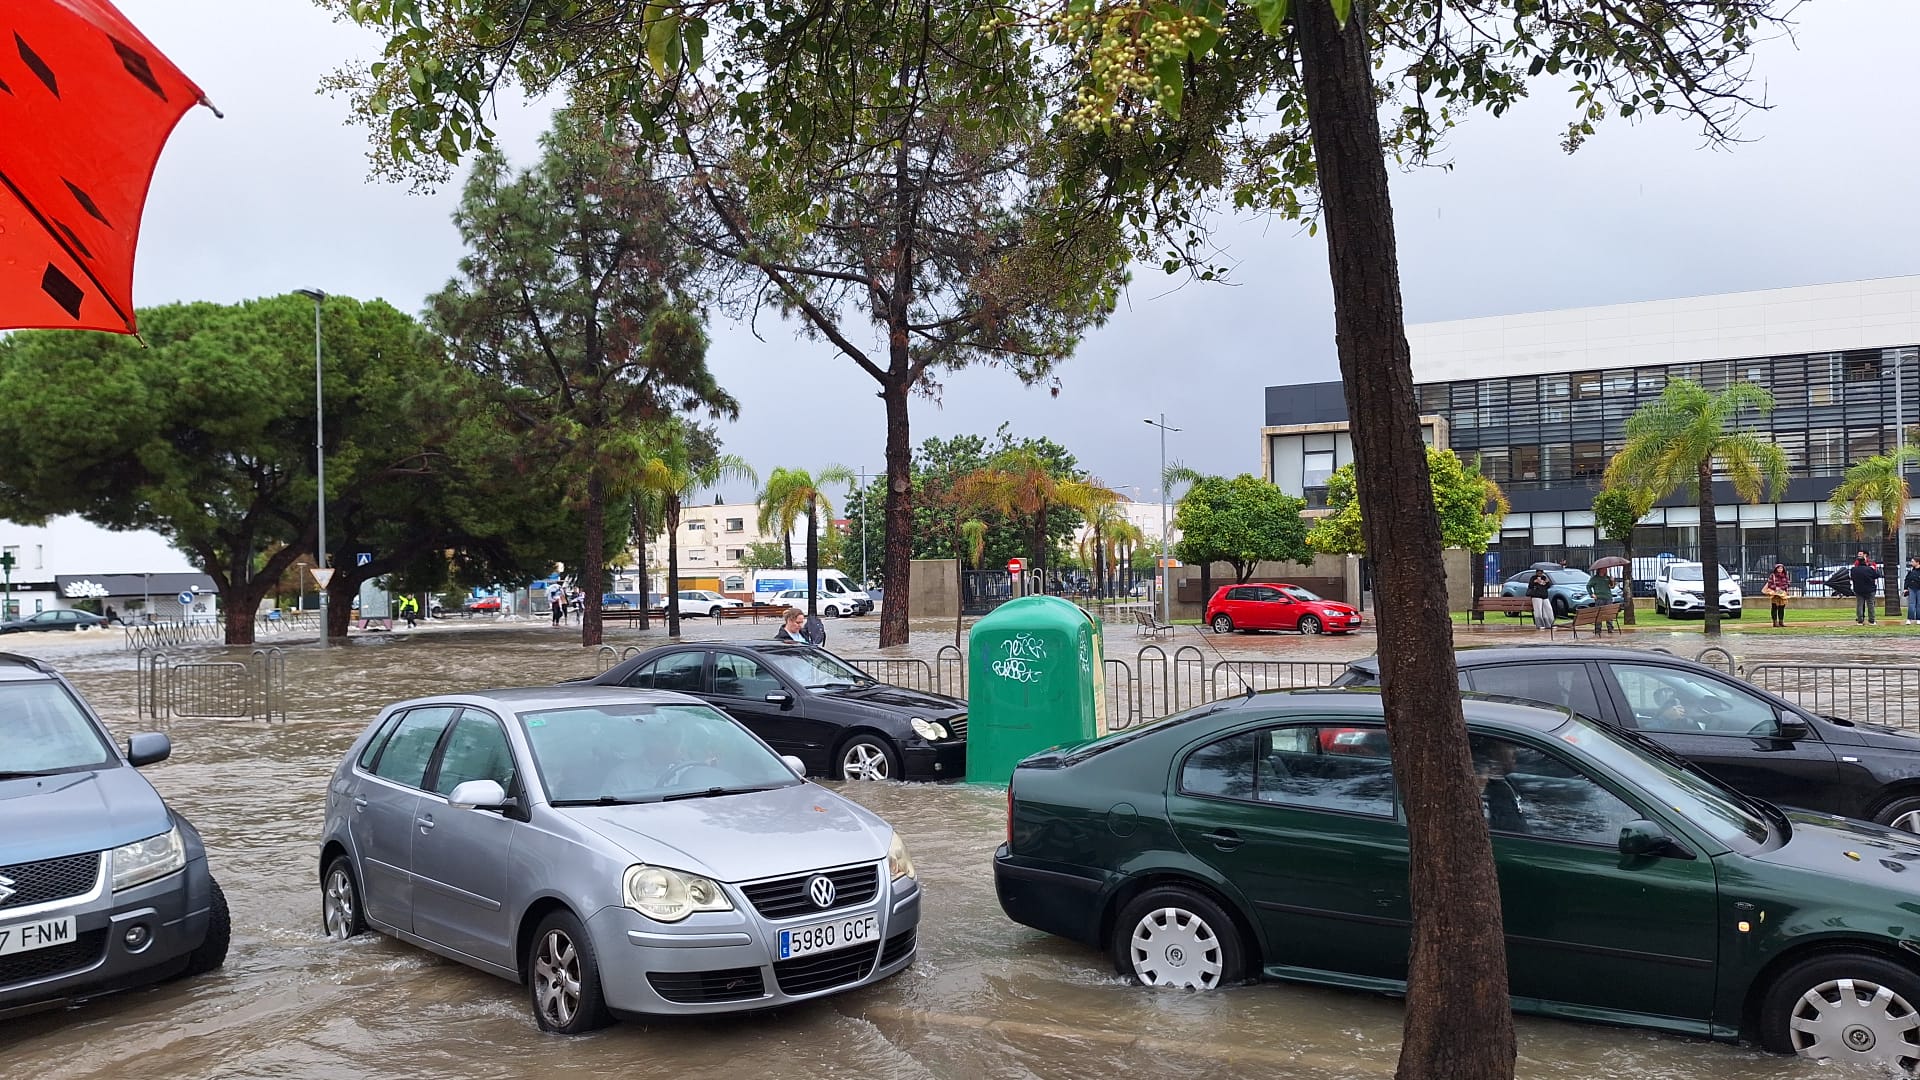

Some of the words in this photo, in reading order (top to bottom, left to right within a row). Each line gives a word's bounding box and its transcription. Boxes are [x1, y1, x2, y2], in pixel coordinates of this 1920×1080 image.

[810, 876, 836, 907] VW
[22, 920, 68, 947] FNM
[792, 926, 835, 953] 5980
[843, 917, 874, 942] GCF
